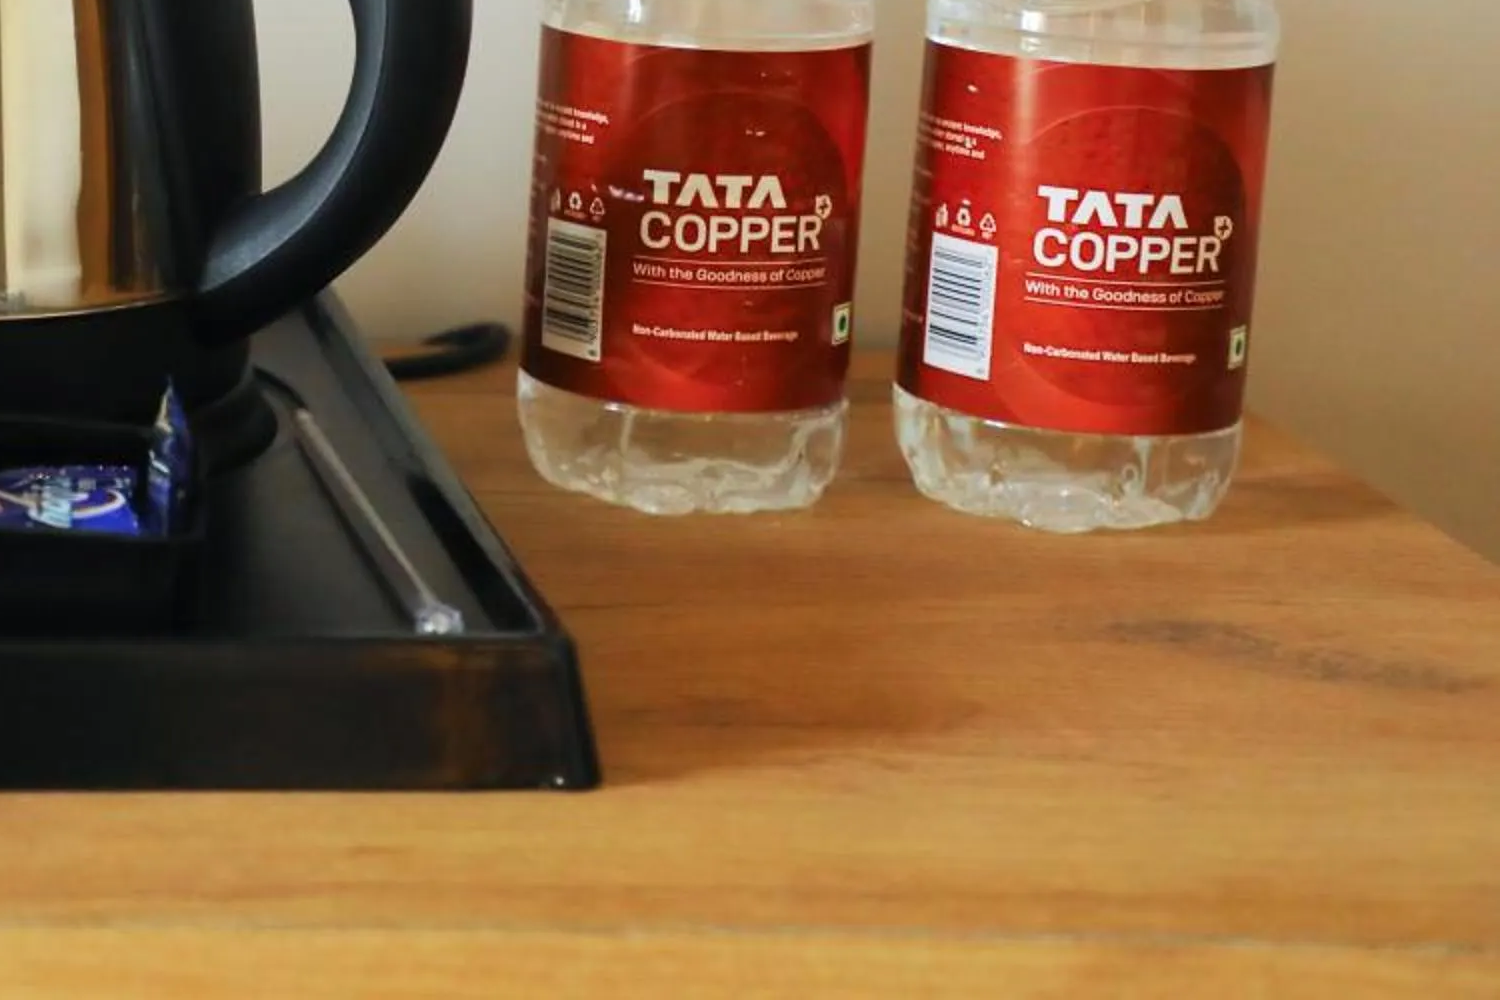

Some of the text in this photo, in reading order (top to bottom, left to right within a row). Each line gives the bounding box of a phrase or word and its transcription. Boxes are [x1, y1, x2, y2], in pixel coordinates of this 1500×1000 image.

[643, 169, 787, 209] TATA
[1037, 185, 1189, 229] TATA
[640, 211, 822, 253] COPPER
[1033, 228, 1222, 274] COPPER
[633, 262, 826, 282] With the Goodness of Copper
[1025, 280, 1060, 297] With
[1064, 285, 1089, 299] the
[1092, 287, 1166, 303] Goodness
[1169, 288, 1183, 303] of
[632, 323, 706, 341] Non-Carbonated
[707, 329, 733, 341] Water
[1023, 342, 1100, 361] Non-Carbonated
[1102, 350, 1129, 362] Water
